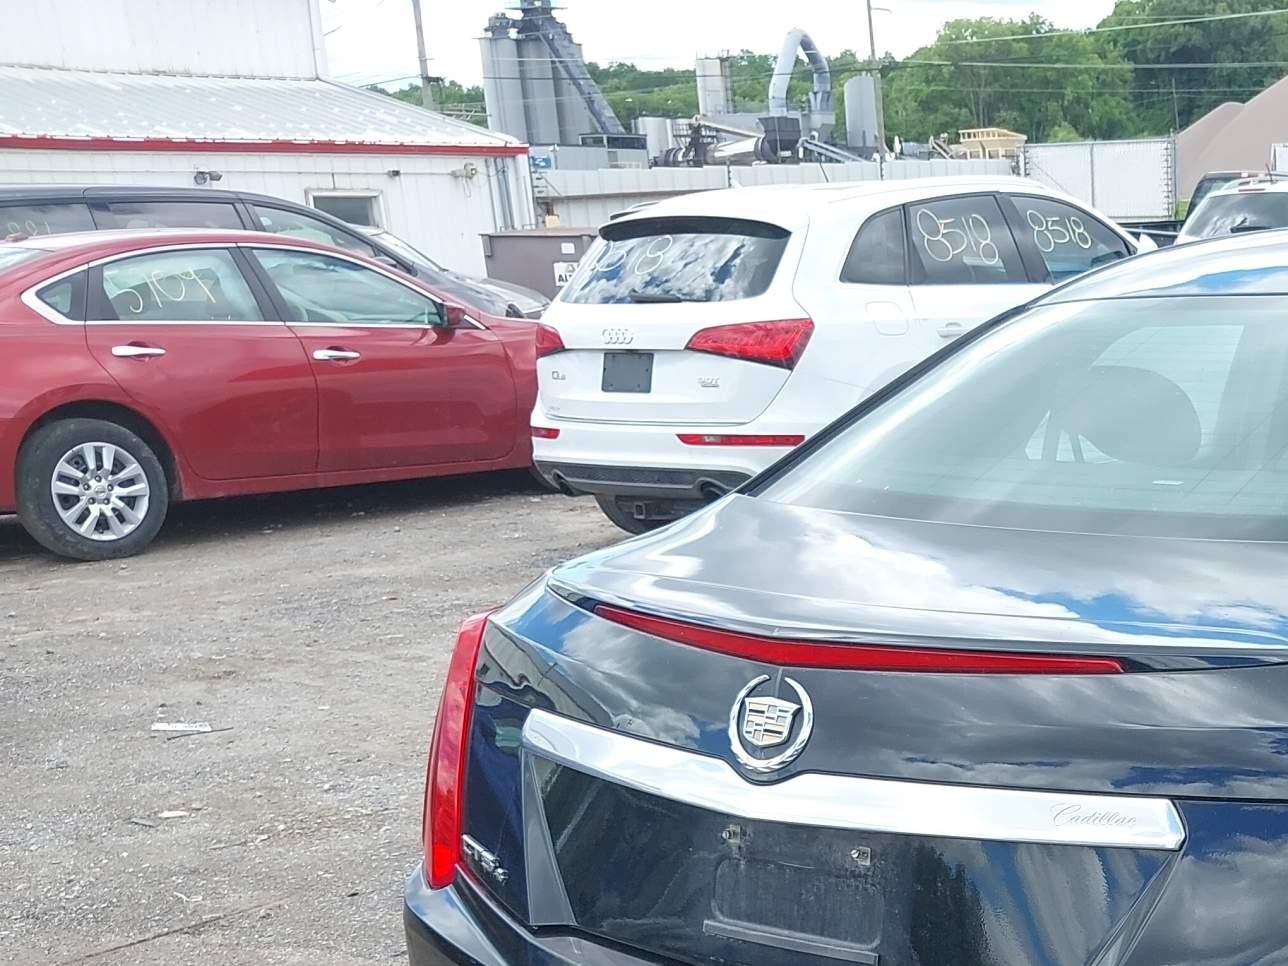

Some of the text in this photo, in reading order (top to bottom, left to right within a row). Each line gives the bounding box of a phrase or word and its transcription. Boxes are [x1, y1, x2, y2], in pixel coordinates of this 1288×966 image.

[916, 208, 1000, 264] 8518
[1026, 209, 1092, 253] 8518
[1048, 801, 1137, 829] Cadillac
